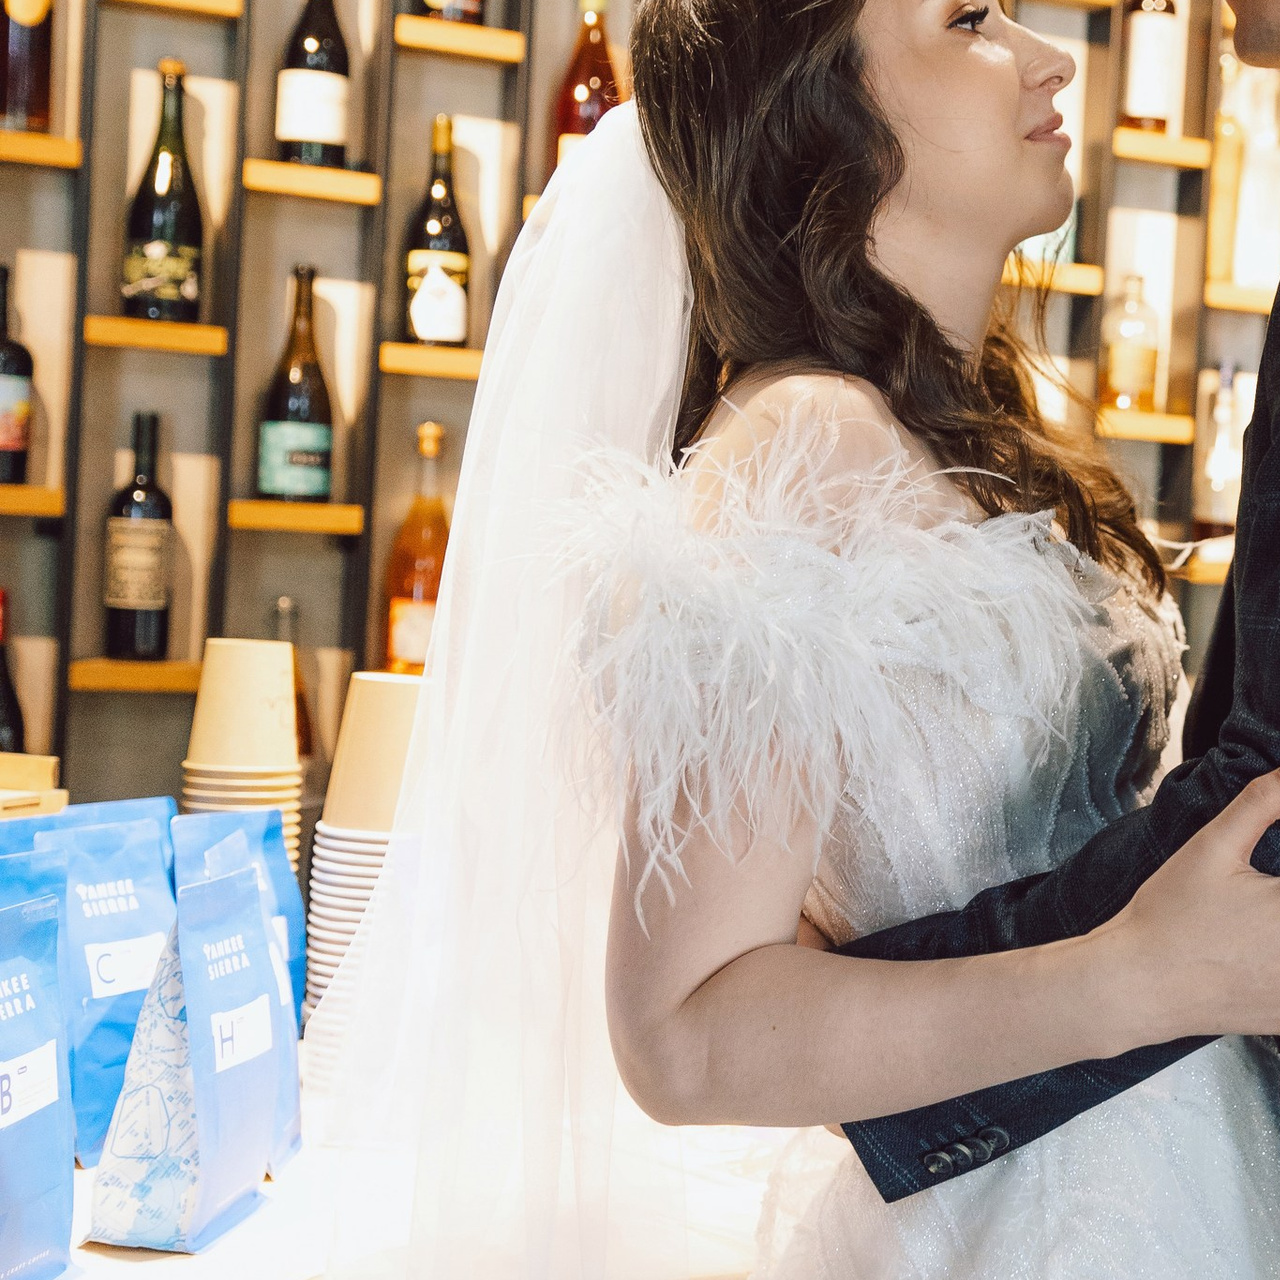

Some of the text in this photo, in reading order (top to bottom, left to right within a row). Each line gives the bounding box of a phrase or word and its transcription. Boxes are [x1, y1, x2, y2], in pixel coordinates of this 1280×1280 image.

[75, 878, 135, 901] YANKEE
[82, 894, 140, 918] SIERRA
[203, 934, 245, 962] YANKEE
[208, 952, 251, 981] SIERRA
[219, 1020, 235, 1059] H
